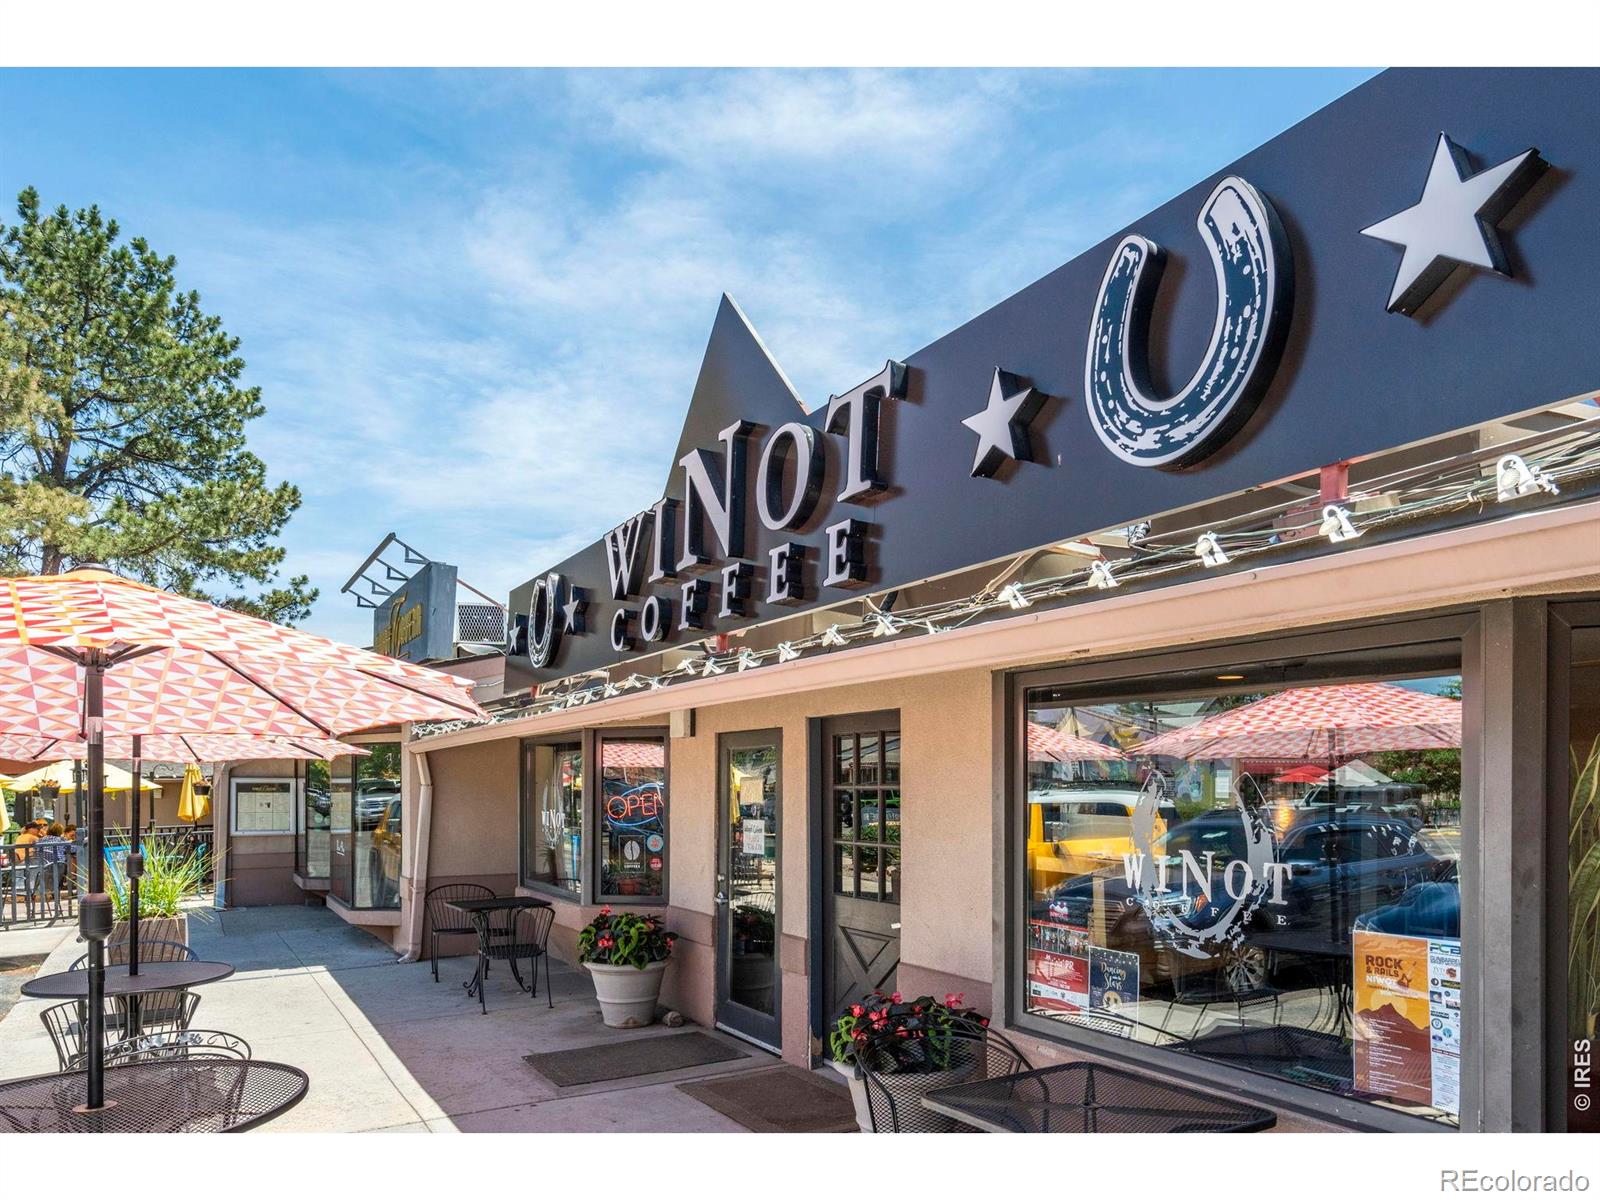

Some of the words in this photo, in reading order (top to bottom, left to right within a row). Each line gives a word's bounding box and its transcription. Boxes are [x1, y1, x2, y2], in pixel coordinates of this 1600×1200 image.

[603, 359, 900, 600] WINOT
[610, 518, 862, 651] COFFEE
[1121, 849, 1293, 905] WINOT
[1101, 961, 1127, 981] Dancing
[1365, 954, 1403, 970] ROCK
[1365, 966, 1373, 974] &
[1374, 966, 1400, 978] RAILS
